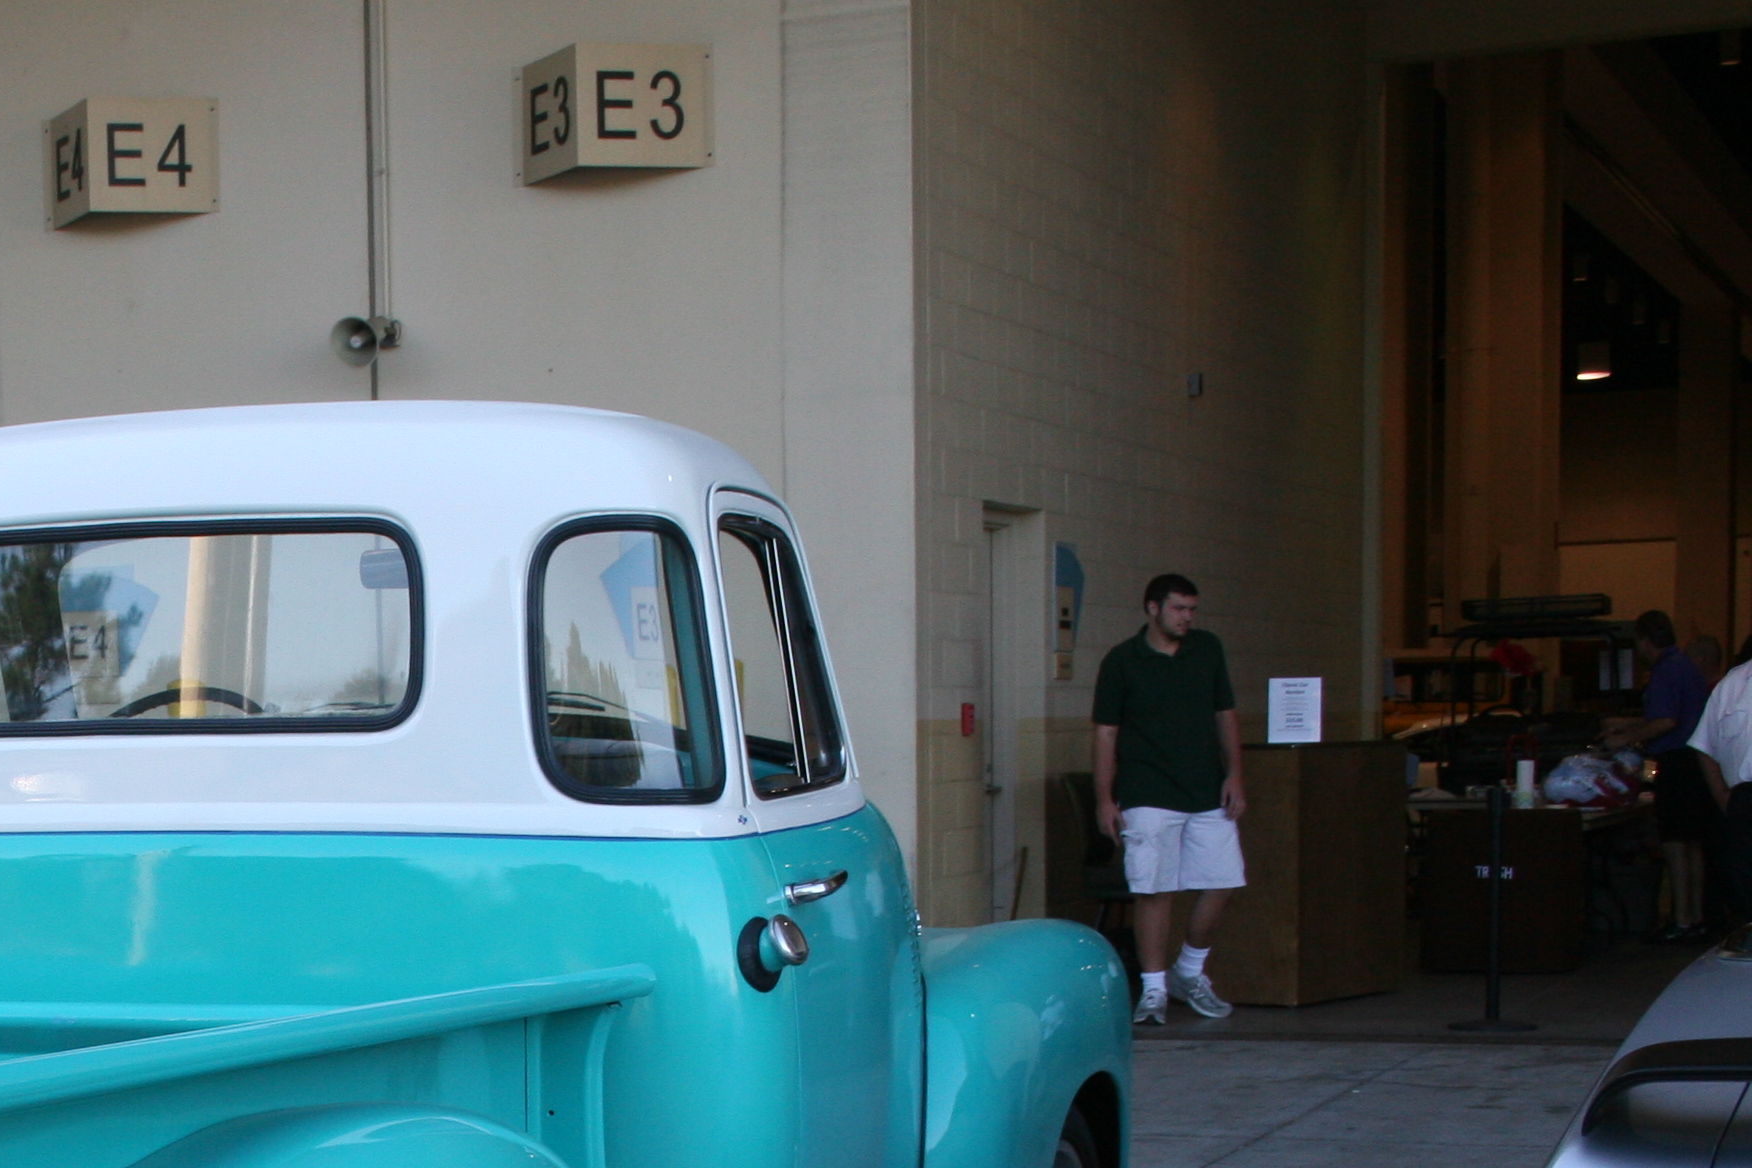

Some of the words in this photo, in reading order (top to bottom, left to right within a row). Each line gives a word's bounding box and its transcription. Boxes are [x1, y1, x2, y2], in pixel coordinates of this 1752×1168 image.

[530, 75, 570, 156] E3
[596, 70, 685, 140] E3
[55, 128, 83, 201] E4
[106, 122, 192, 187] E4
[69, 625, 108, 660] E4
[636, 603, 659, 642] E3
